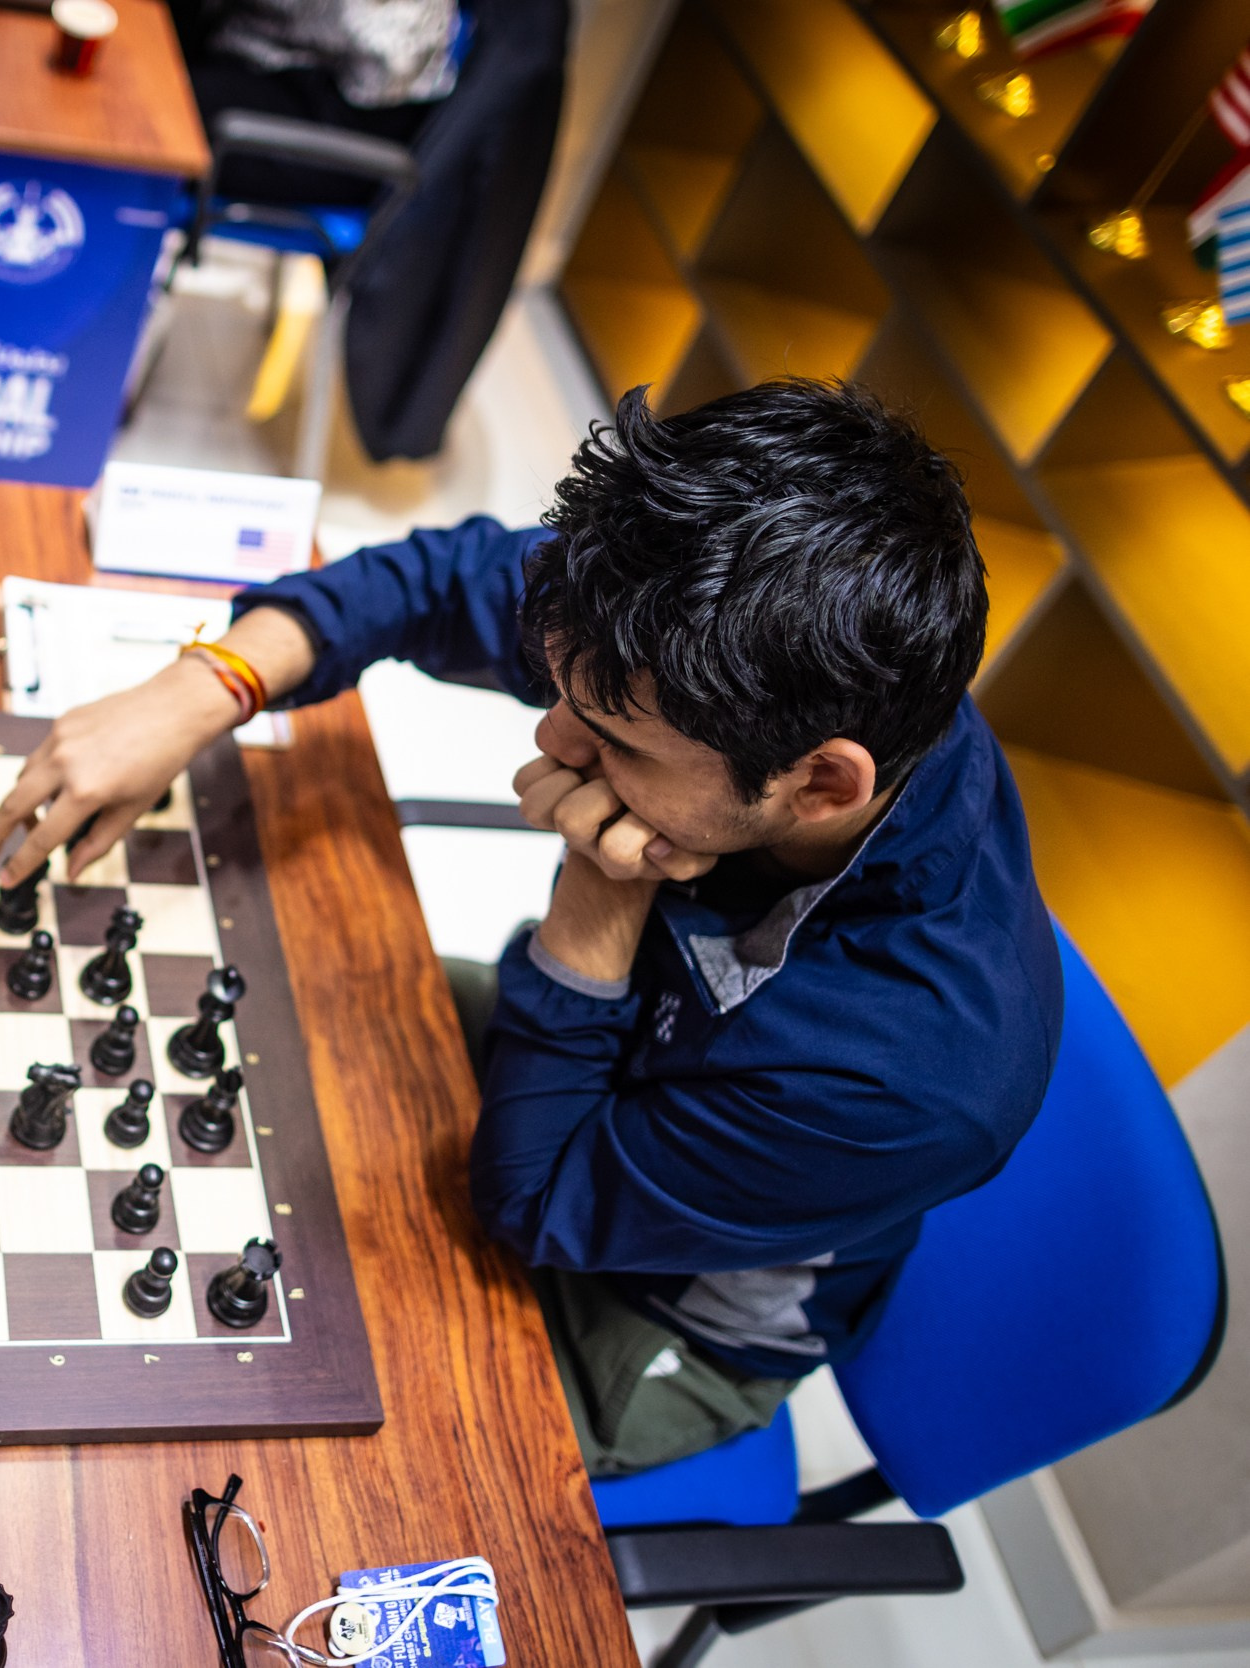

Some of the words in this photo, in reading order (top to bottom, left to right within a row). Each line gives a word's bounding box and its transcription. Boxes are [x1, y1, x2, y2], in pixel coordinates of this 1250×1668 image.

[49, 1354, 66, 1366] 6
[144, 1353, 160, 1365] 7
[236, 1351, 254, 1363] 8
